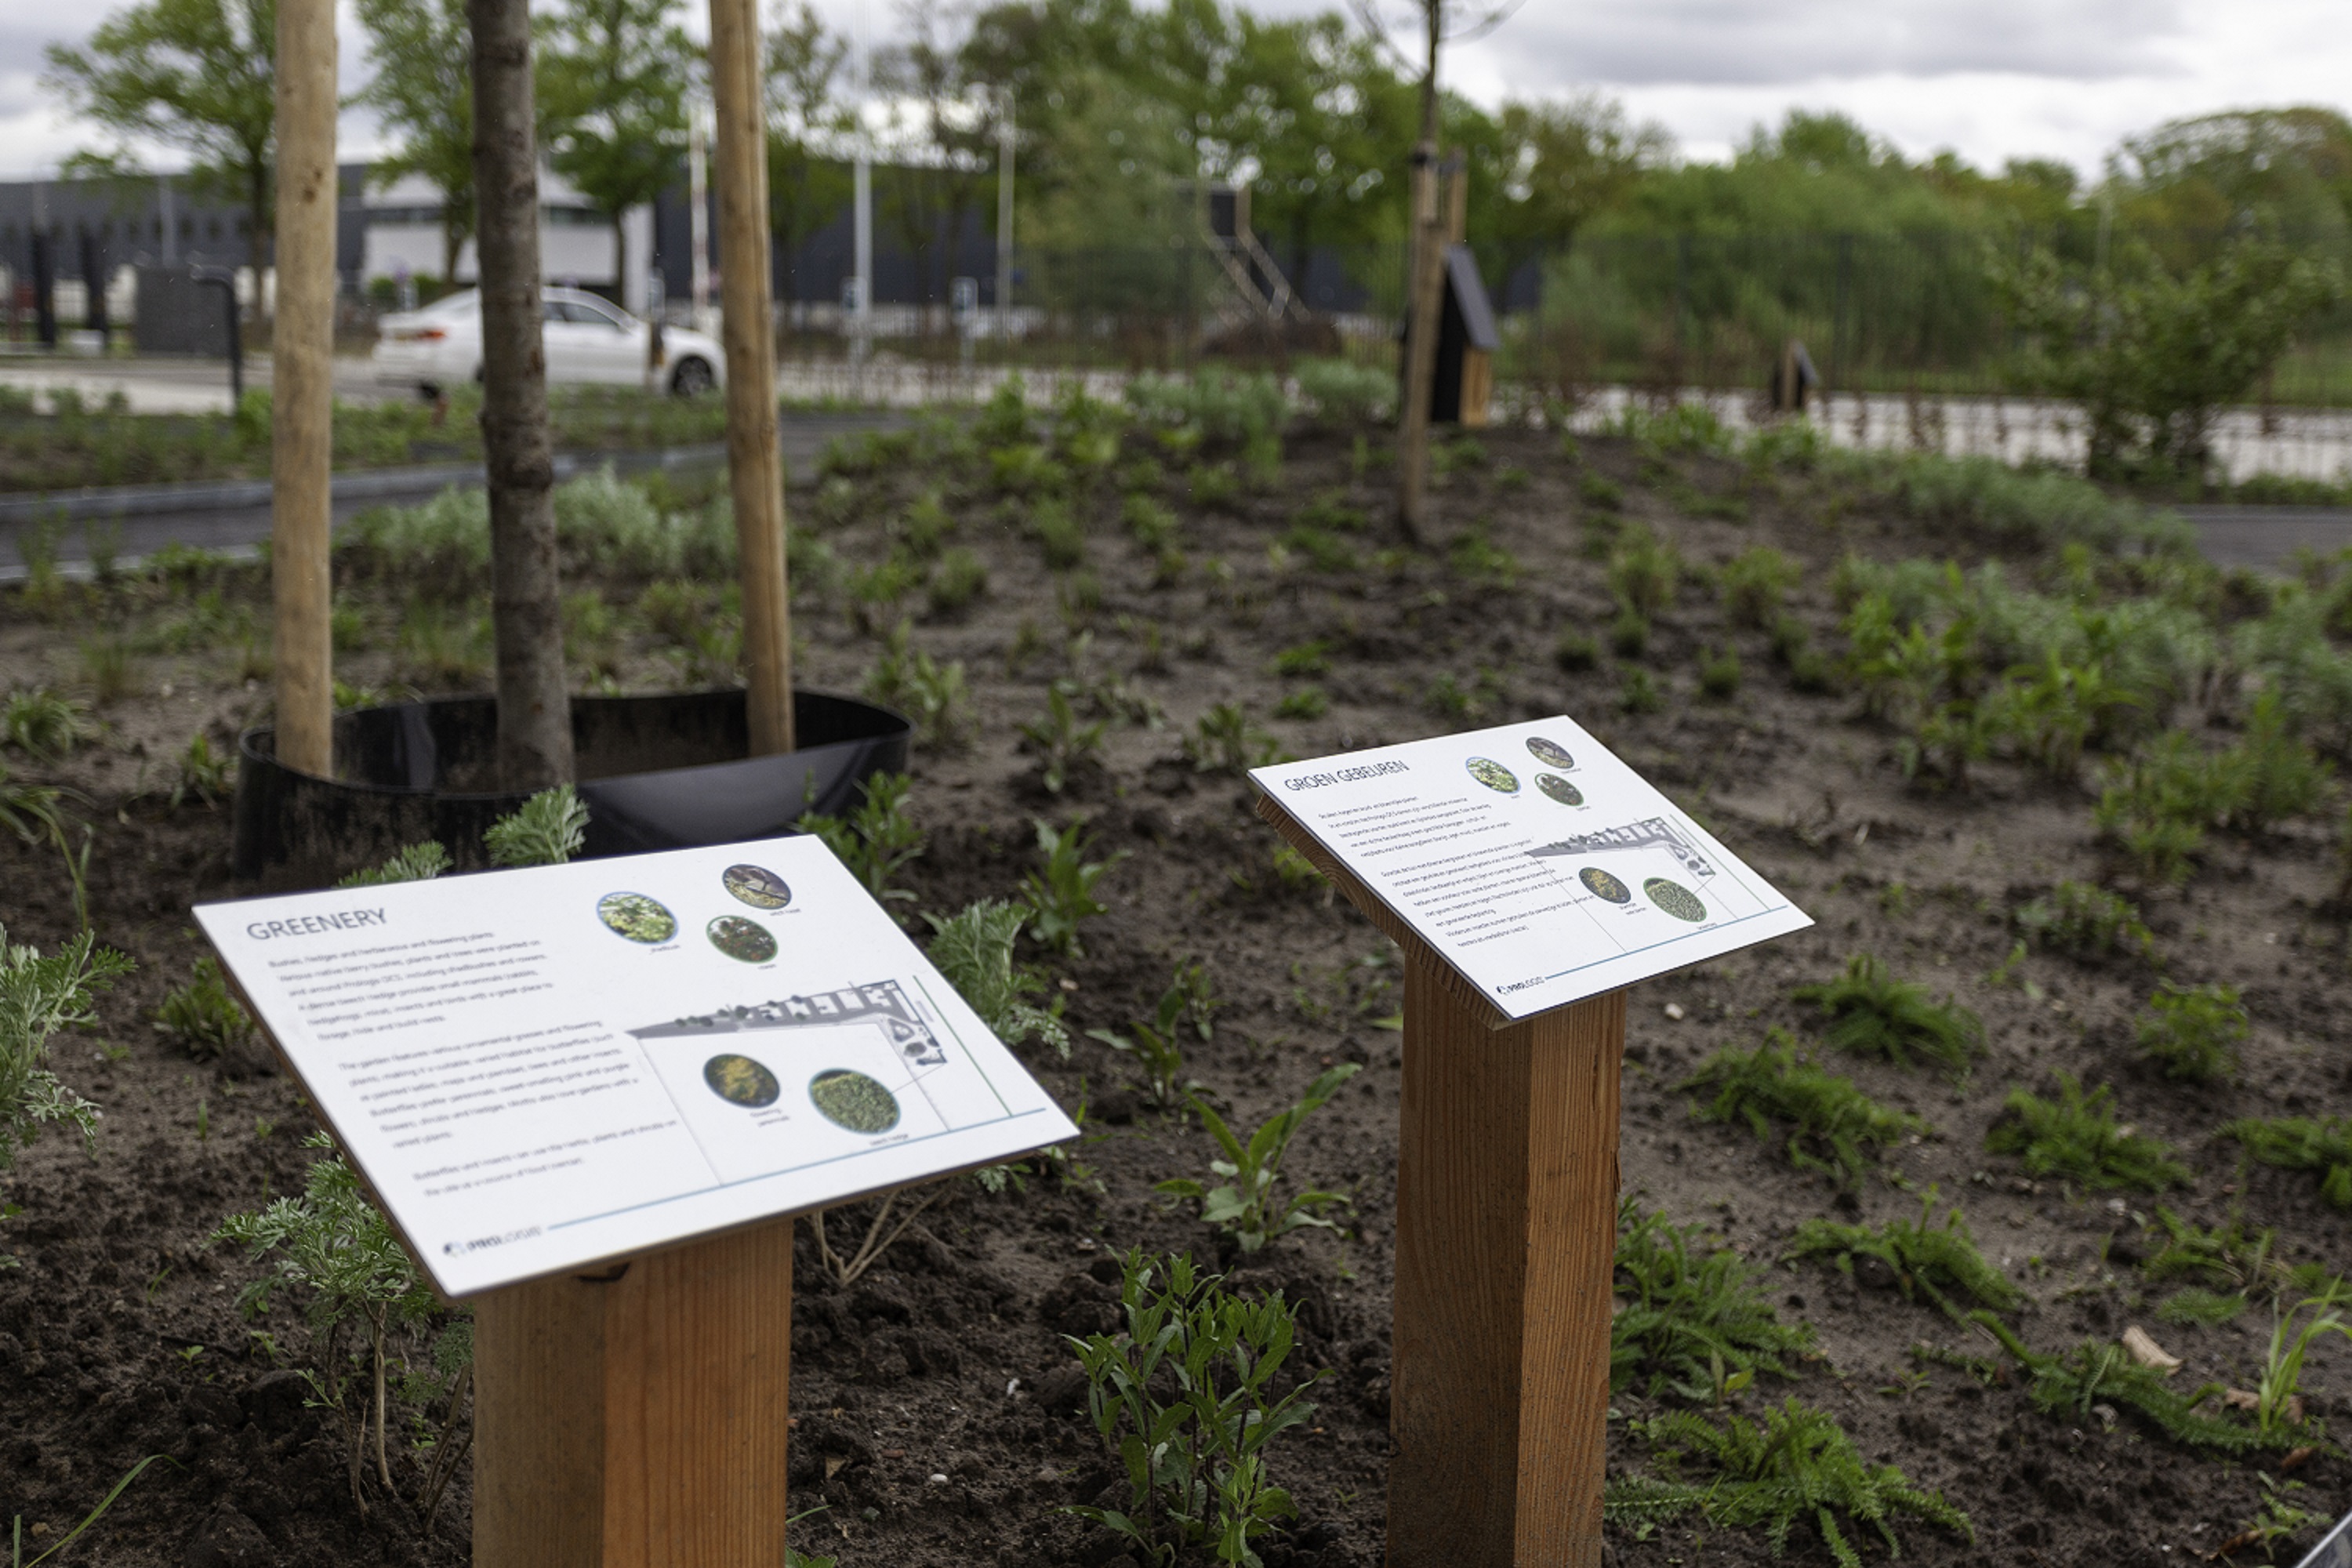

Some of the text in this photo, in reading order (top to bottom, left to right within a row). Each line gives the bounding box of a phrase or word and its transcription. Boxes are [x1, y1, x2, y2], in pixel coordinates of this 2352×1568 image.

[1283, 760, 1410, 790] GROEN GEBEUREN
[246, 908, 386, 939] GREENERY
